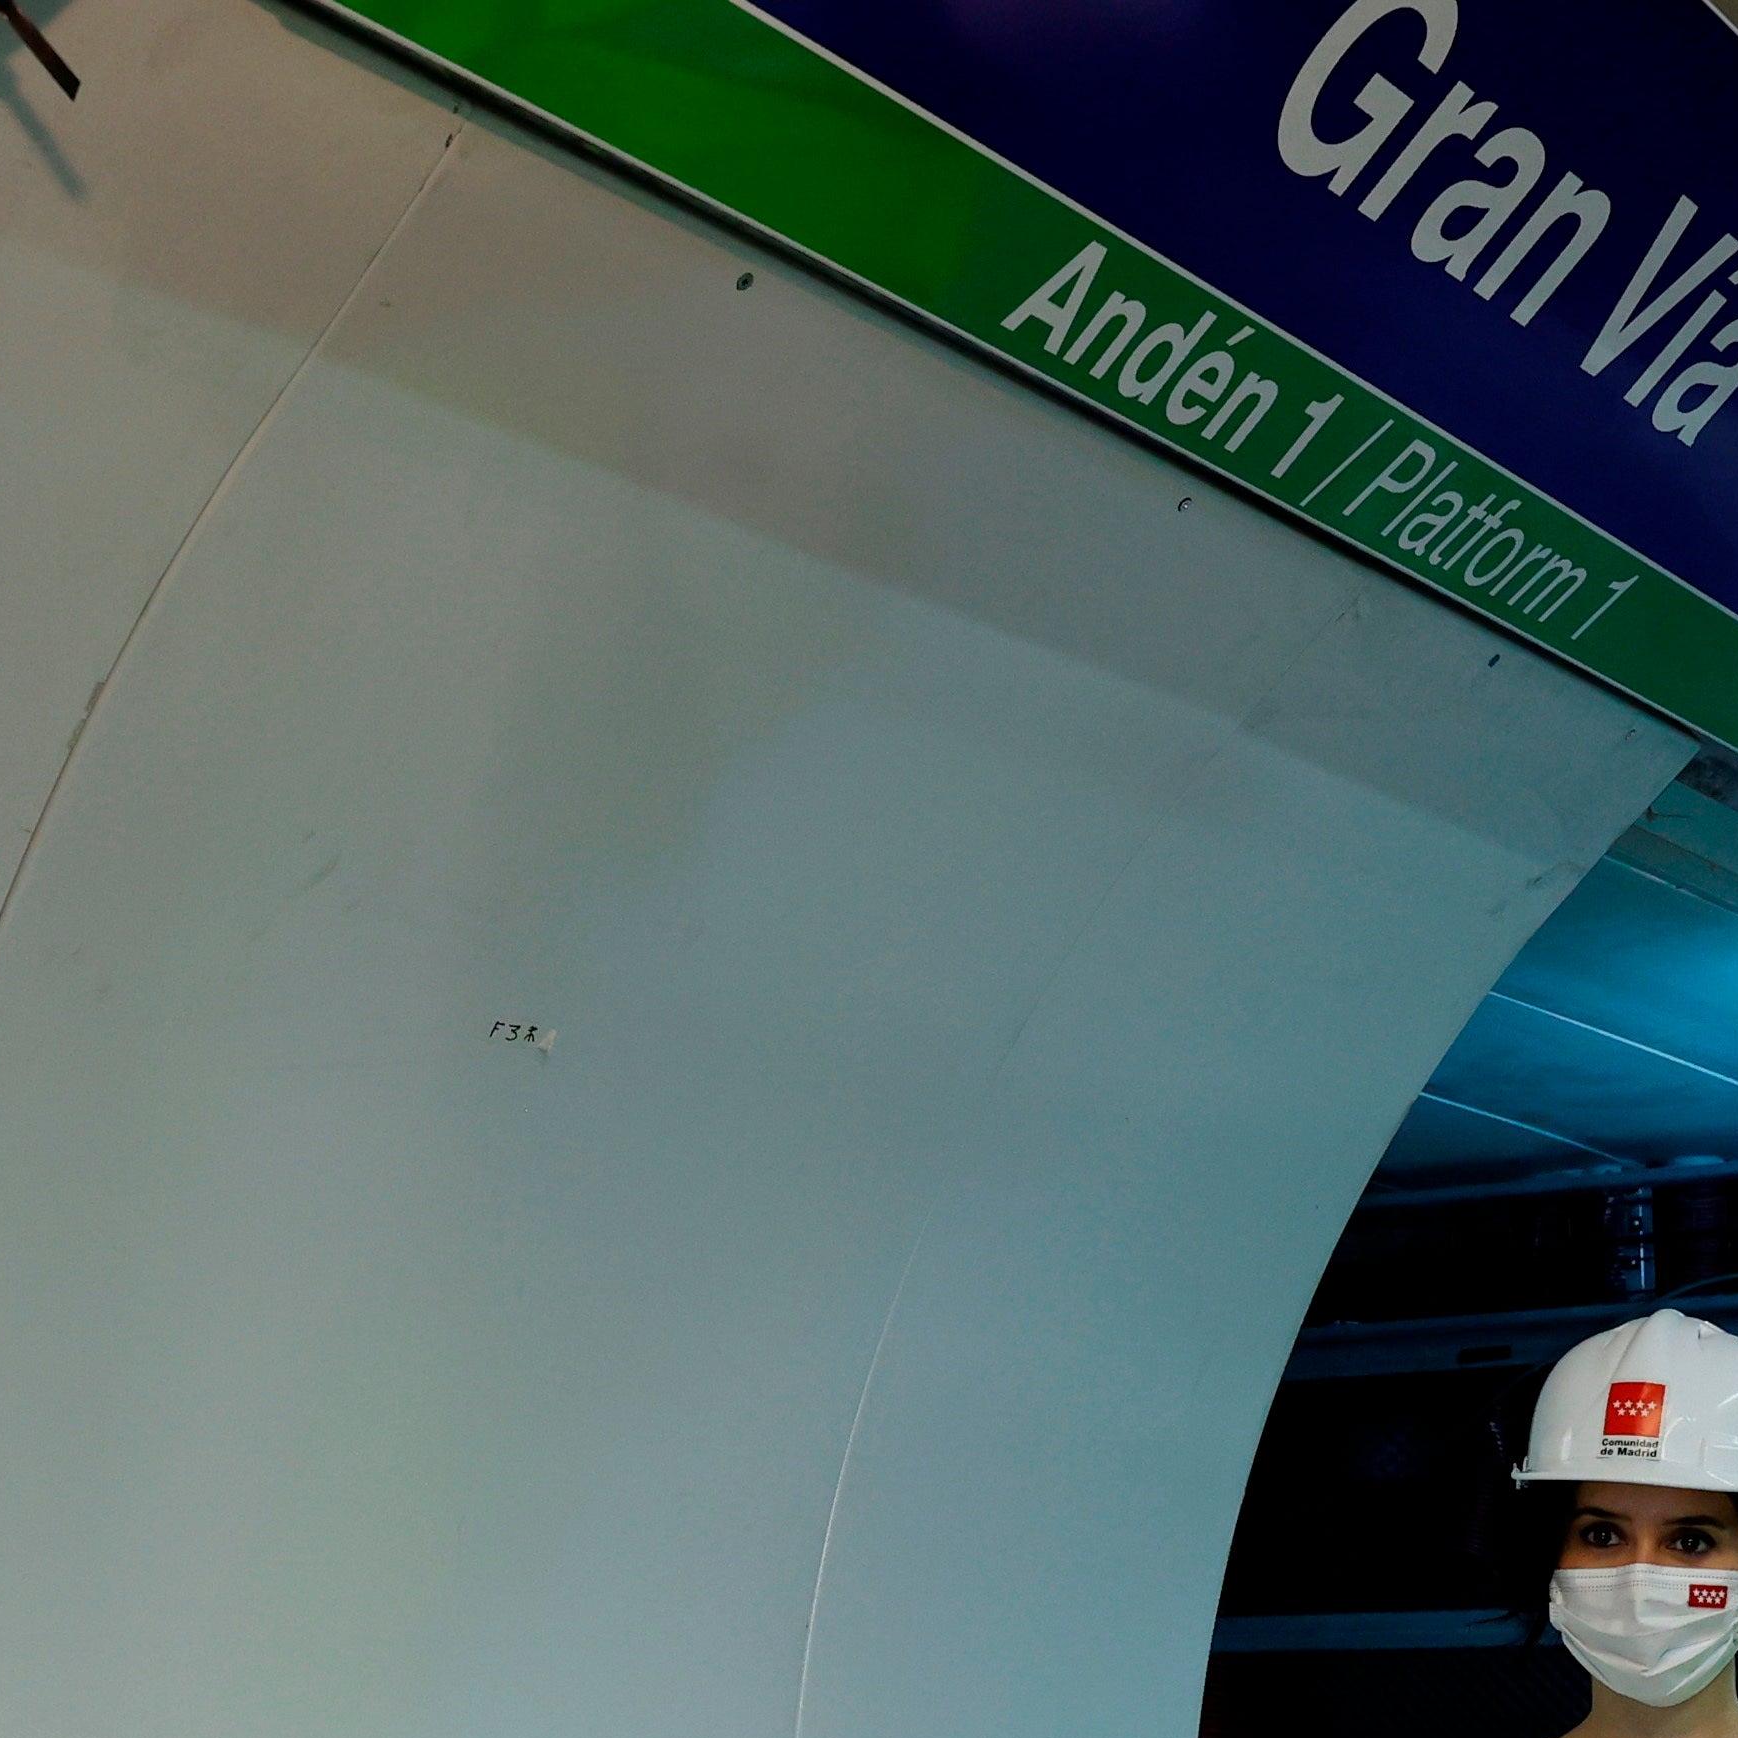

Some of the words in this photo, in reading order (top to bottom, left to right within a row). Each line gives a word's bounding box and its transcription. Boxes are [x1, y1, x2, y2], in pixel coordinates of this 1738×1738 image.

[1278, 0, 1611, 327] Gran
[1002, 241, 1278, 452] Andén
[1272, 394, 1344, 478] 1
[1344, 441, 1587, 624] Platform
[1571, 574, 1639, 640] 1
[1600, 1447, 1614, 1456] de
[1617, 1447, 1657, 1458] Madrid
[1602, 1438, 1659, 1448] Comunidad
